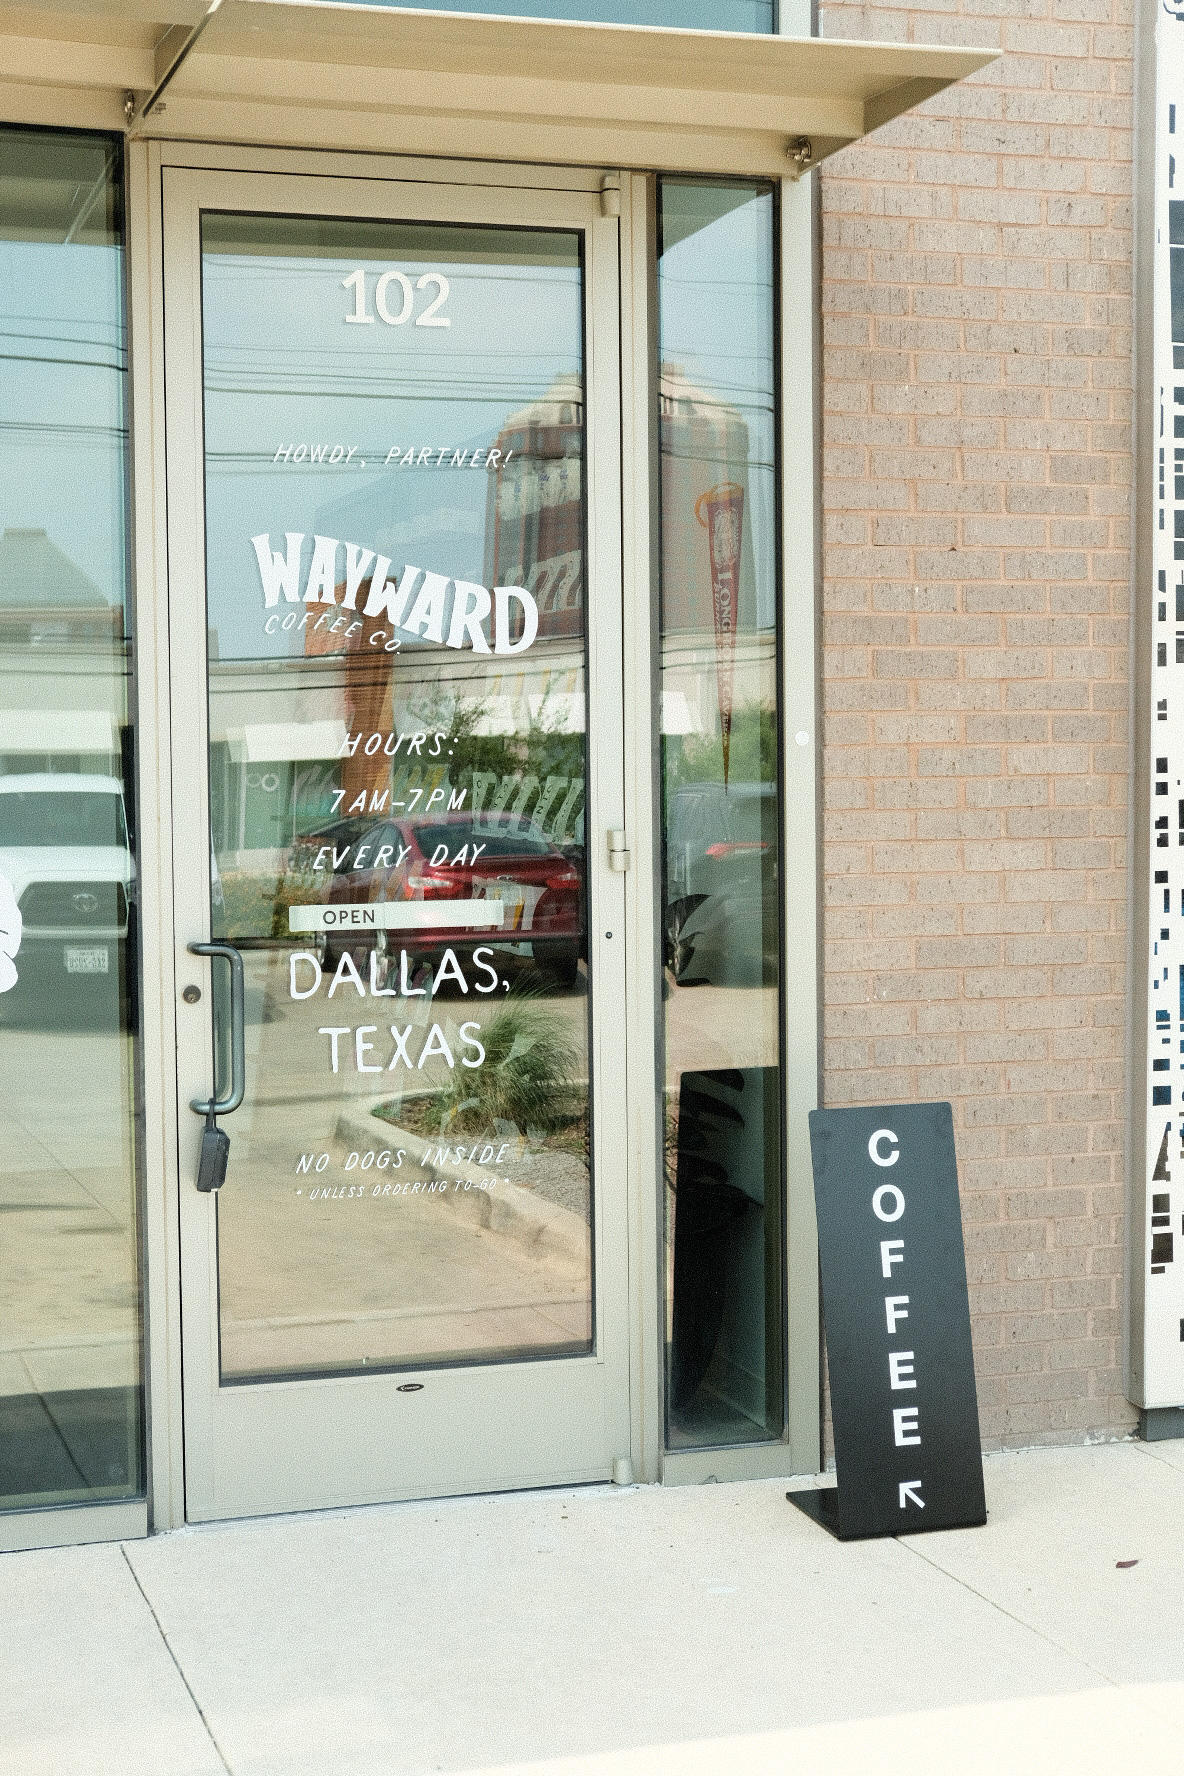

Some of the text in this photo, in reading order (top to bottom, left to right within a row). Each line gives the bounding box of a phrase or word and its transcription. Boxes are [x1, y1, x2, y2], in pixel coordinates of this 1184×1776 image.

[341, 269, 450, 327] 102
[273, 445, 513, 469] HOWDY, PARTNER!
[250, 532, 539, 655] WAYWARD
[264, 611, 402, 655] COFFEE CO.
[339, 732, 457, 757] HOURS:
[313, 843, 486, 870] EVERY DAY
[322, 909, 375, 925] OPEN
[289, 947, 510, 999] DALLAS,
[318, 1023, 485, 1073] TEXAS
[296, 1143, 510, 1175] NO DOGS INSIDE
[309, 1178, 497, 1200] UNLESS ORDERING TO-GO
[868, 1129, 921, 1447] COFFEE
